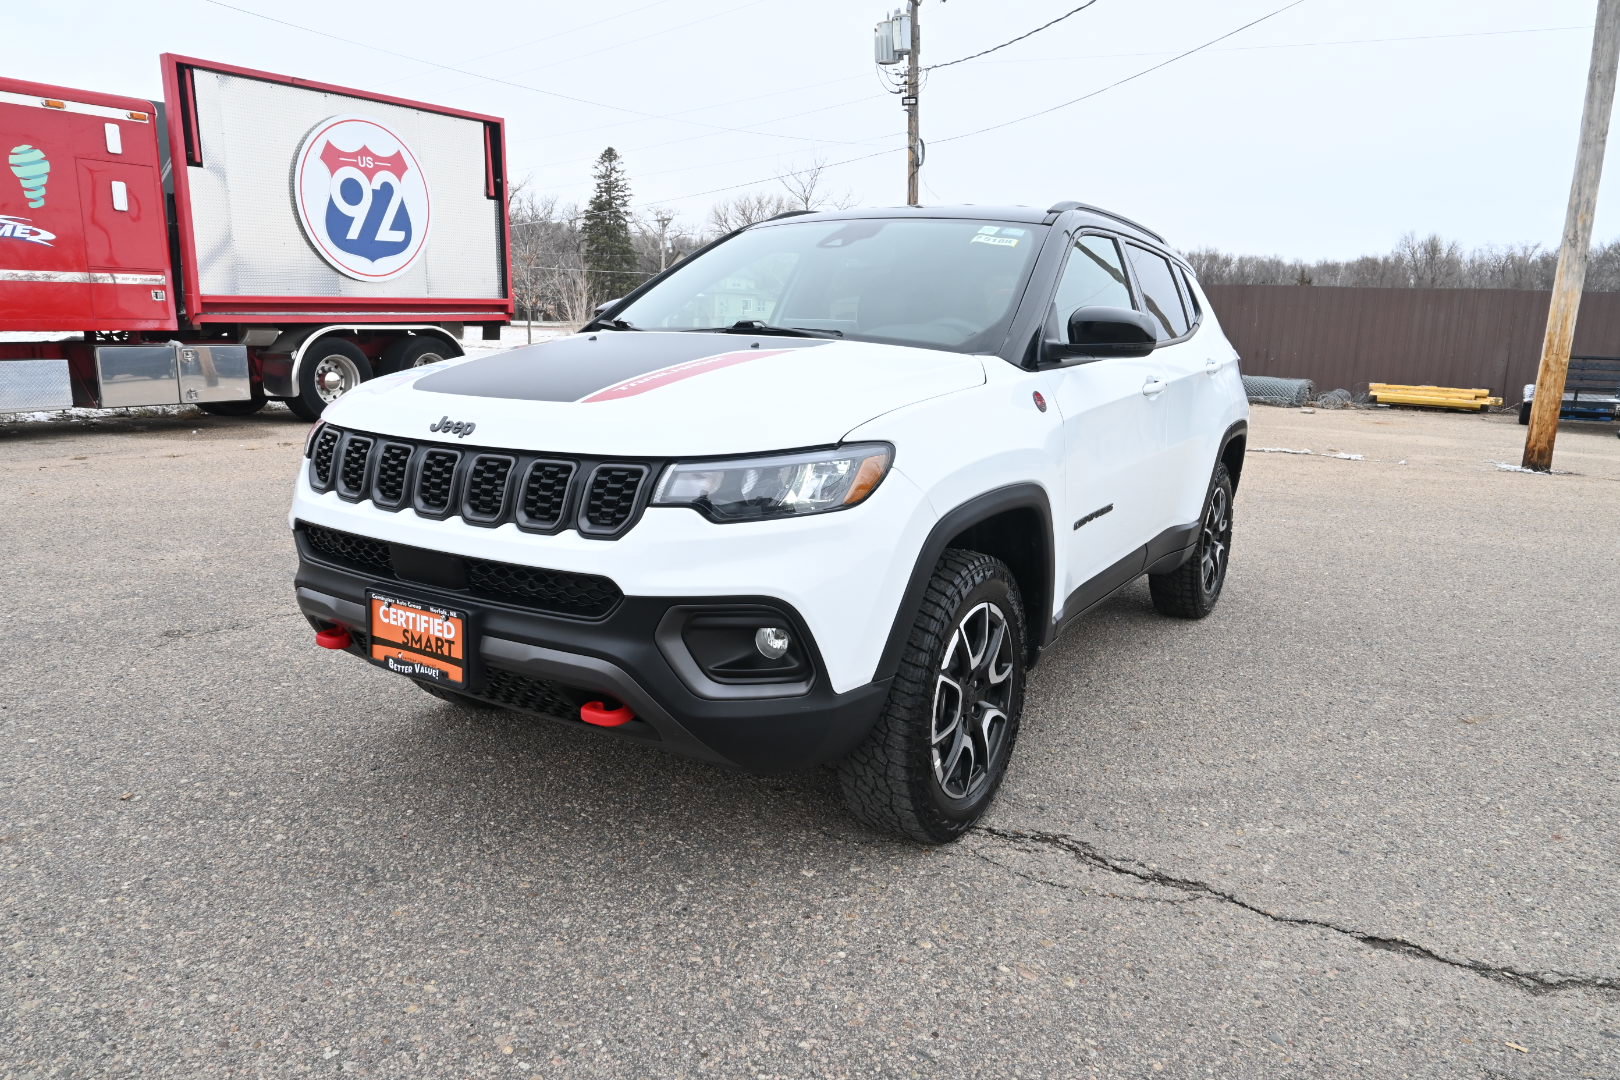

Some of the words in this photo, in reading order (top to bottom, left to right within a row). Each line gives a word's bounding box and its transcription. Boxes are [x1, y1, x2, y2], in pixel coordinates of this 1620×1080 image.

[358, 155, 374, 168] US
[330, 166, 406, 242] 92
[430, 415, 476, 438] Jeep
[379, 605, 456, 639] CERTIFIED
[401, 629, 455, 657] SMART
